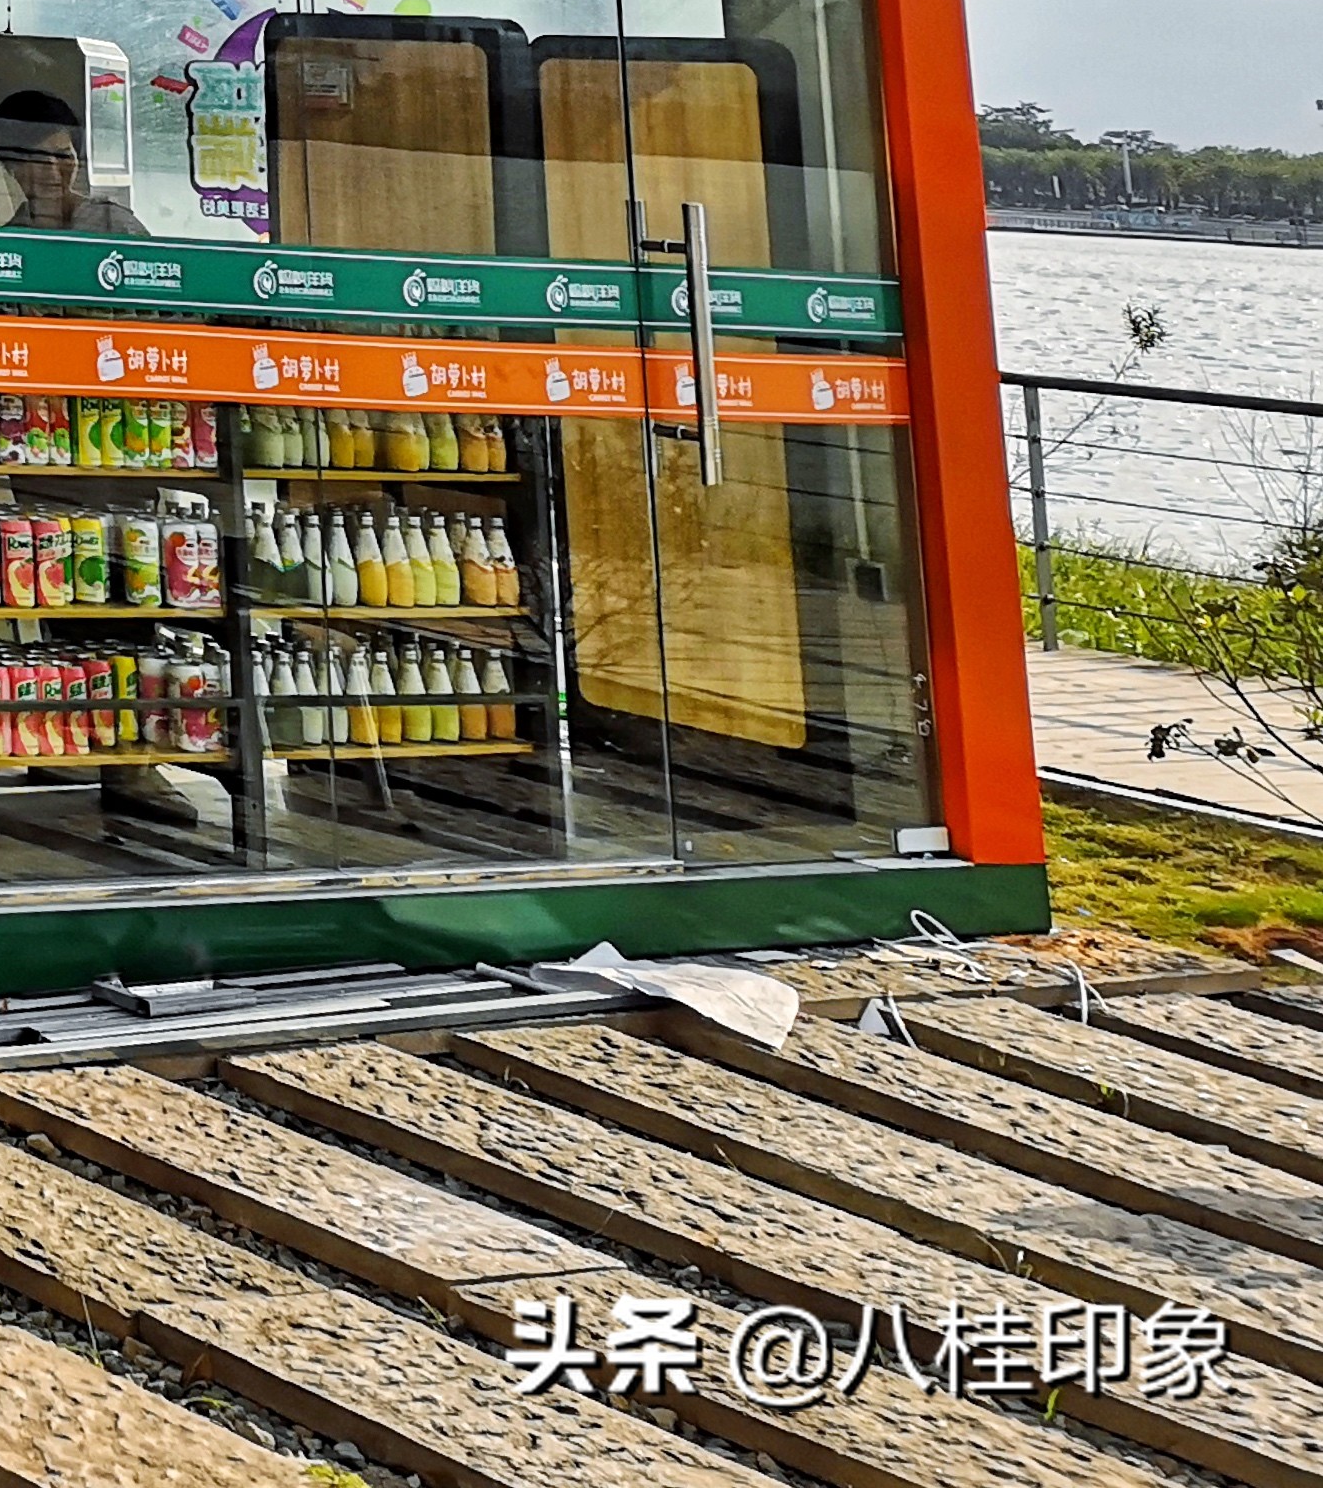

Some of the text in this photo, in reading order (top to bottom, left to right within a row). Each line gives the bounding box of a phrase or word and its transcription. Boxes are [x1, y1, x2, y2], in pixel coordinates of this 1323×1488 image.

[126, 346, 187, 374] 胡萝卜村
[717, 373, 751, 398] 萝卜村
